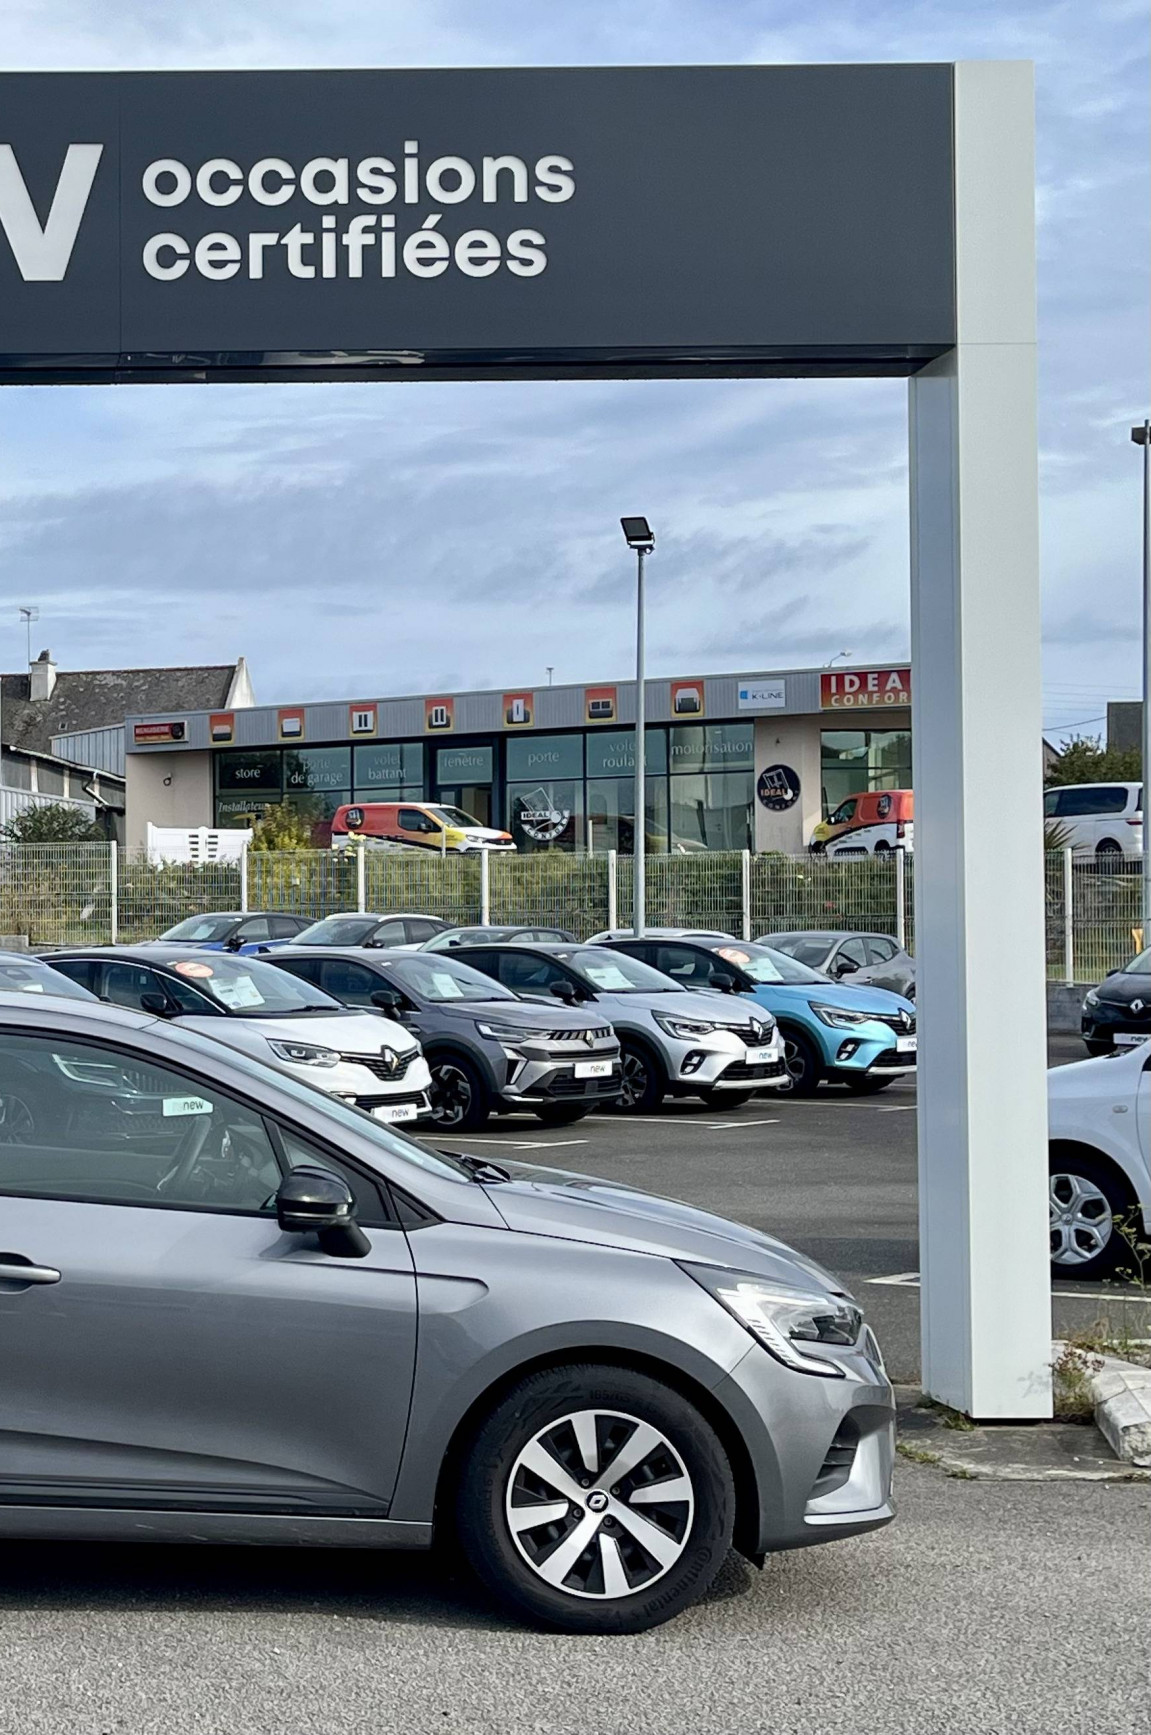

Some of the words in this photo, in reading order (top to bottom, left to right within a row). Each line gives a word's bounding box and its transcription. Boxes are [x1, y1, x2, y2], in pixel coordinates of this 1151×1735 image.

[142, 140, 576, 207] occasions
[142, 214, 548, 281] certifiées
[830, 671, 903, 694] IDEA
[831, 691, 908, 707] CONFOR
[609, 739, 636, 752] vole
[671, 739, 753, 755] motorisation
[528, 751, 560, 766] porte
[235, 768, 261, 779] store
[291, 771, 305, 784] de
[307, 771, 344, 787] garage
[368, 767, 407, 780] battant
[760, 788, 786, 797] IDEAL
[218, 800, 265, 812] Installateu
